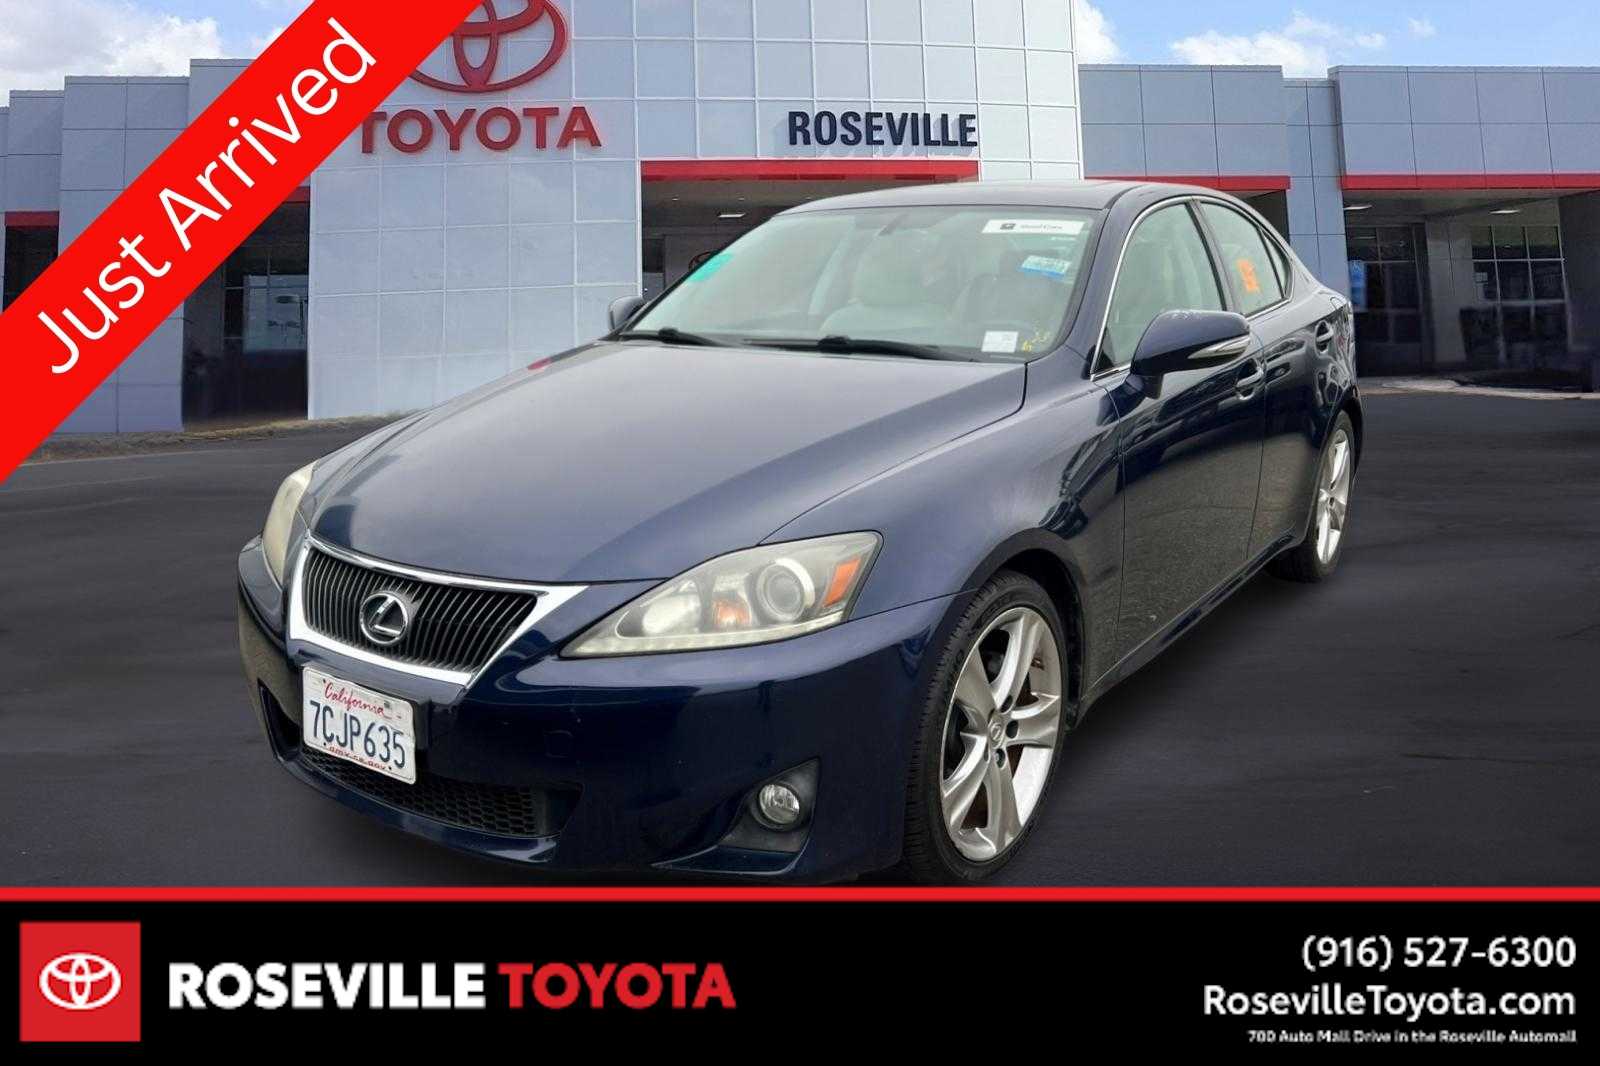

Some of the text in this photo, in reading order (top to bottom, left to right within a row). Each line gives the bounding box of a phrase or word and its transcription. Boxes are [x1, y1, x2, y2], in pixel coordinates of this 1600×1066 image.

[361, 106, 602, 153] TOYOTA
[788, 111, 978, 147] ROSEVILLE
[323, 681, 386, 716] California
[310, 700, 406, 768] 7CJP635
